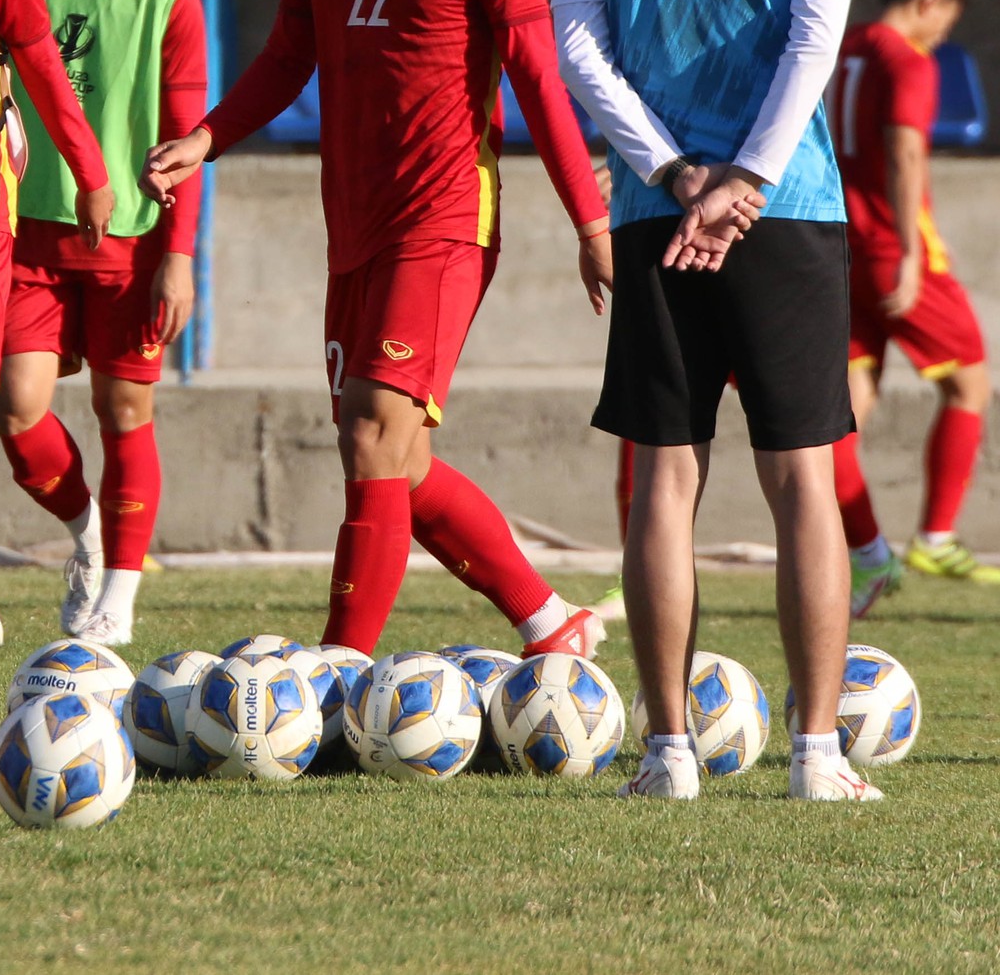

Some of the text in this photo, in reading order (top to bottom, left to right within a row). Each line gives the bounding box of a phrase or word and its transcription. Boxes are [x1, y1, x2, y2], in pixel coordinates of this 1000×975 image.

[327, 340, 345, 396] 2
[27, 674, 77, 692] molten
[244, 678, 258, 731] molten
